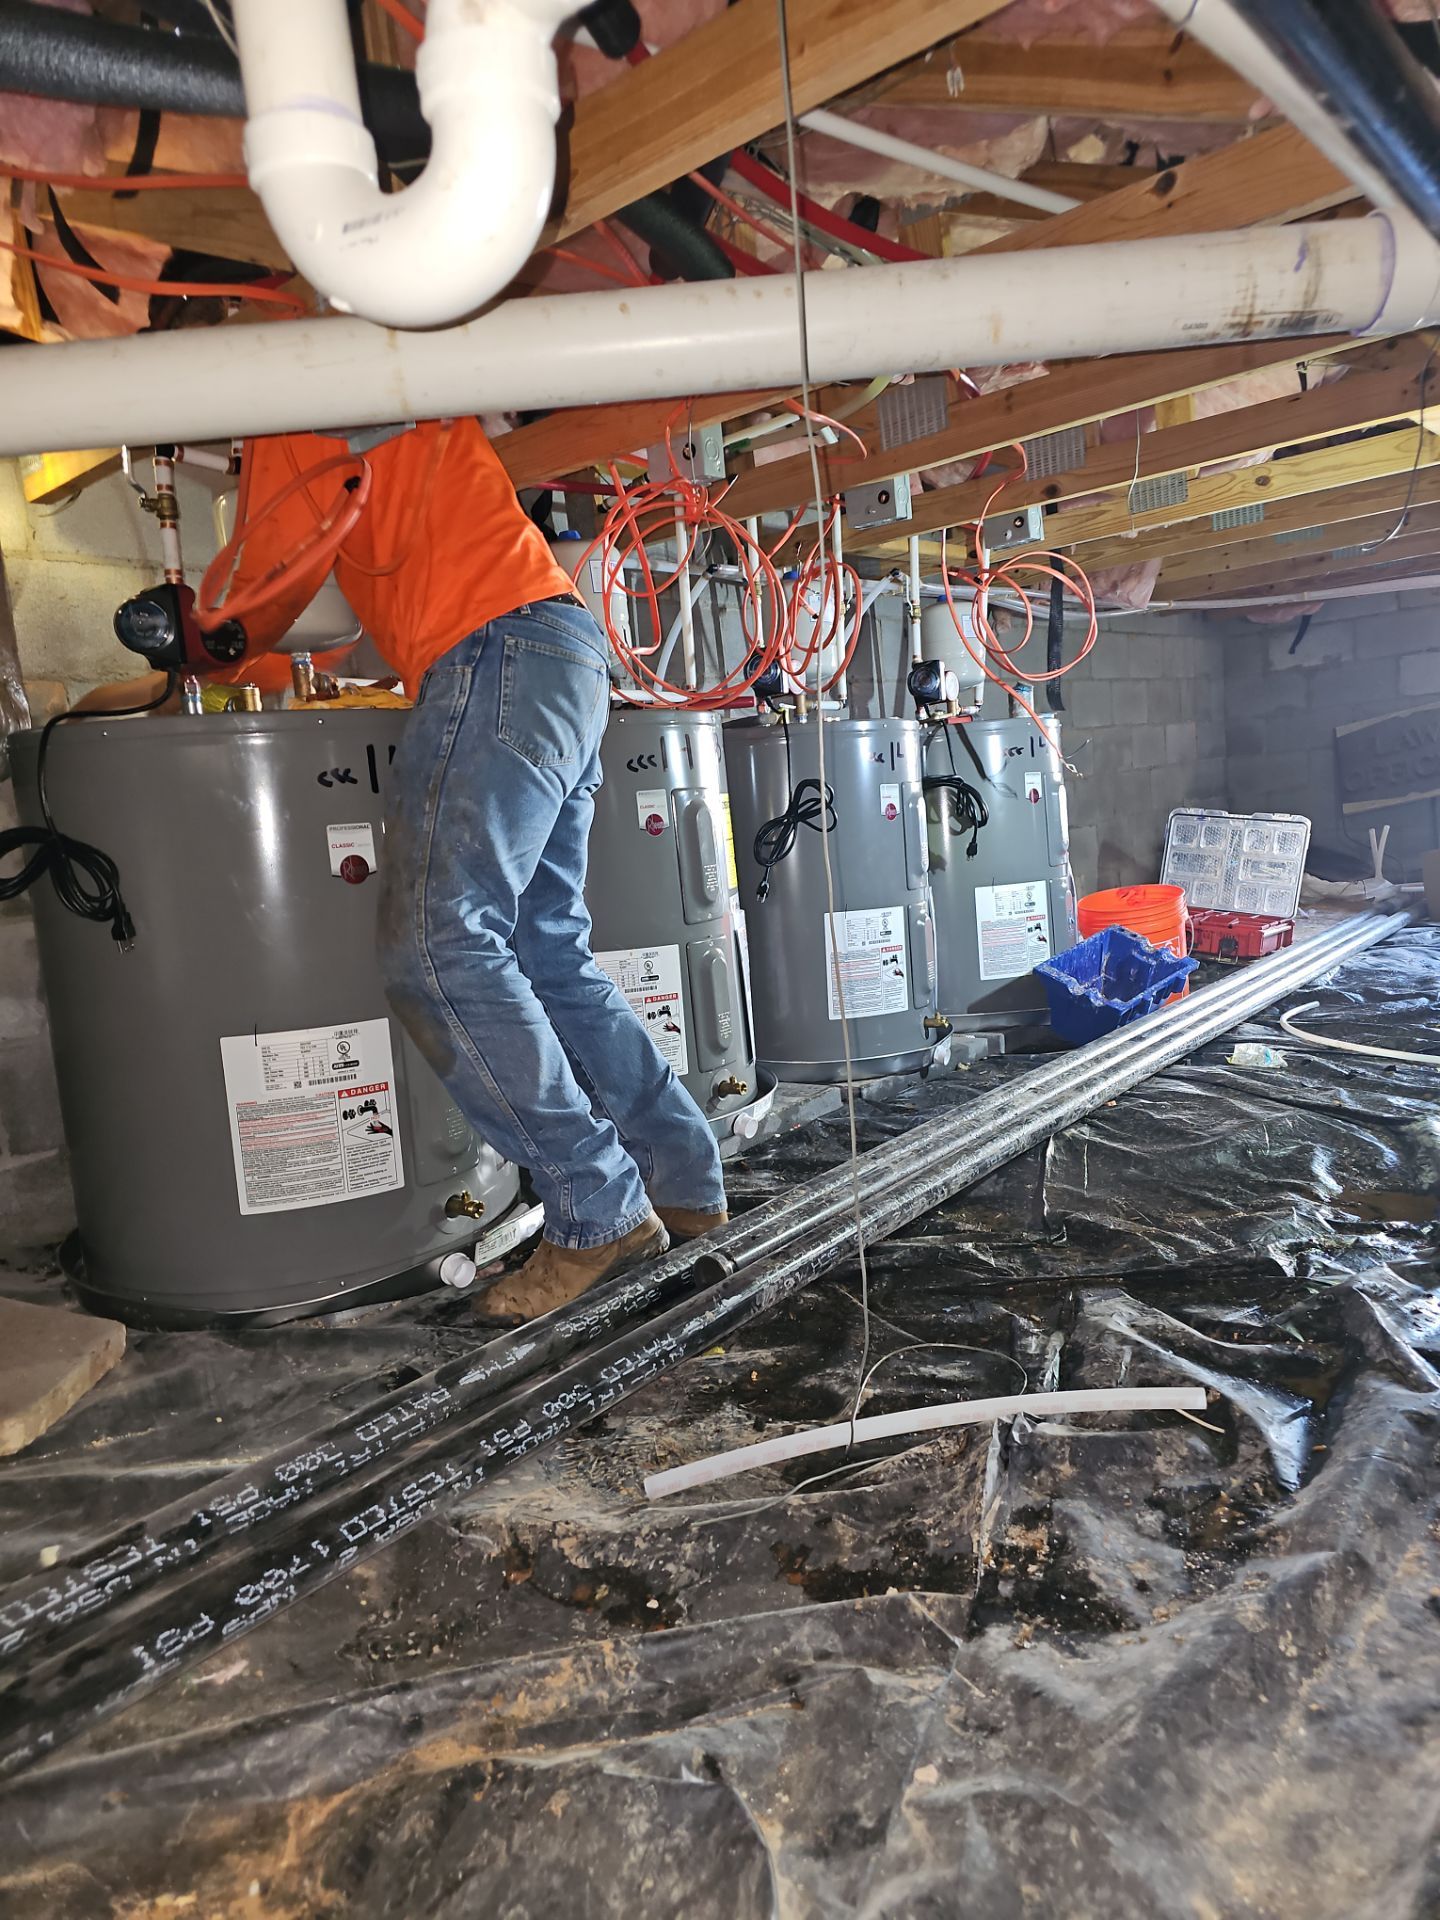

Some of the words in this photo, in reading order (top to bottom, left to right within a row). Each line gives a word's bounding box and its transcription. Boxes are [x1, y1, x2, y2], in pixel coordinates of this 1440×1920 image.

[331, 841, 355, 849] CLASSIC
[350, 1083, 386, 1096] DANGER
[480, 1419, 532, 1457] PSI
[451, 1466, 486, 1496] IN
[339, 1463, 463, 1541] TESTED
[373, 1500, 437, 1544] USA
[47, 1574, 133, 1623] USA
[132, 1613, 215, 1670] PSI
